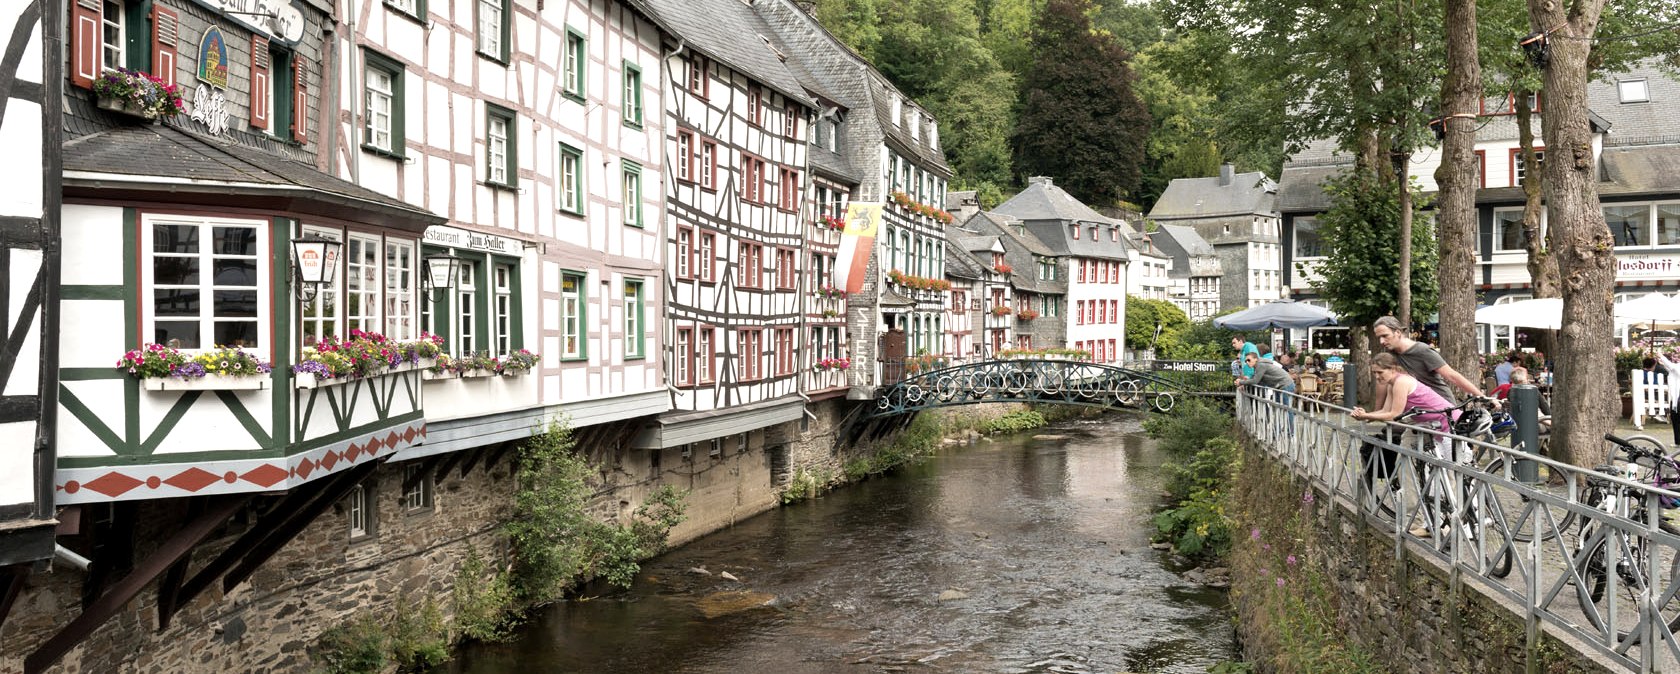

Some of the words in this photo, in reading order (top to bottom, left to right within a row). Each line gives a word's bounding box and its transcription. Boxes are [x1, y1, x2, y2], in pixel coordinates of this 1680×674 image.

[191, 84, 230, 135] Leffe
[425, 229, 460, 244] estaurant
[466, 231, 482, 249] Zum
[483, 235, 505, 250] Haller
[1618, 259, 1672, 272] losdorff
[855, 307, 870, 387] STERN
[1173, 362, 1193, 372] Hotel
[1194, 362, 1215, 372] Stern
